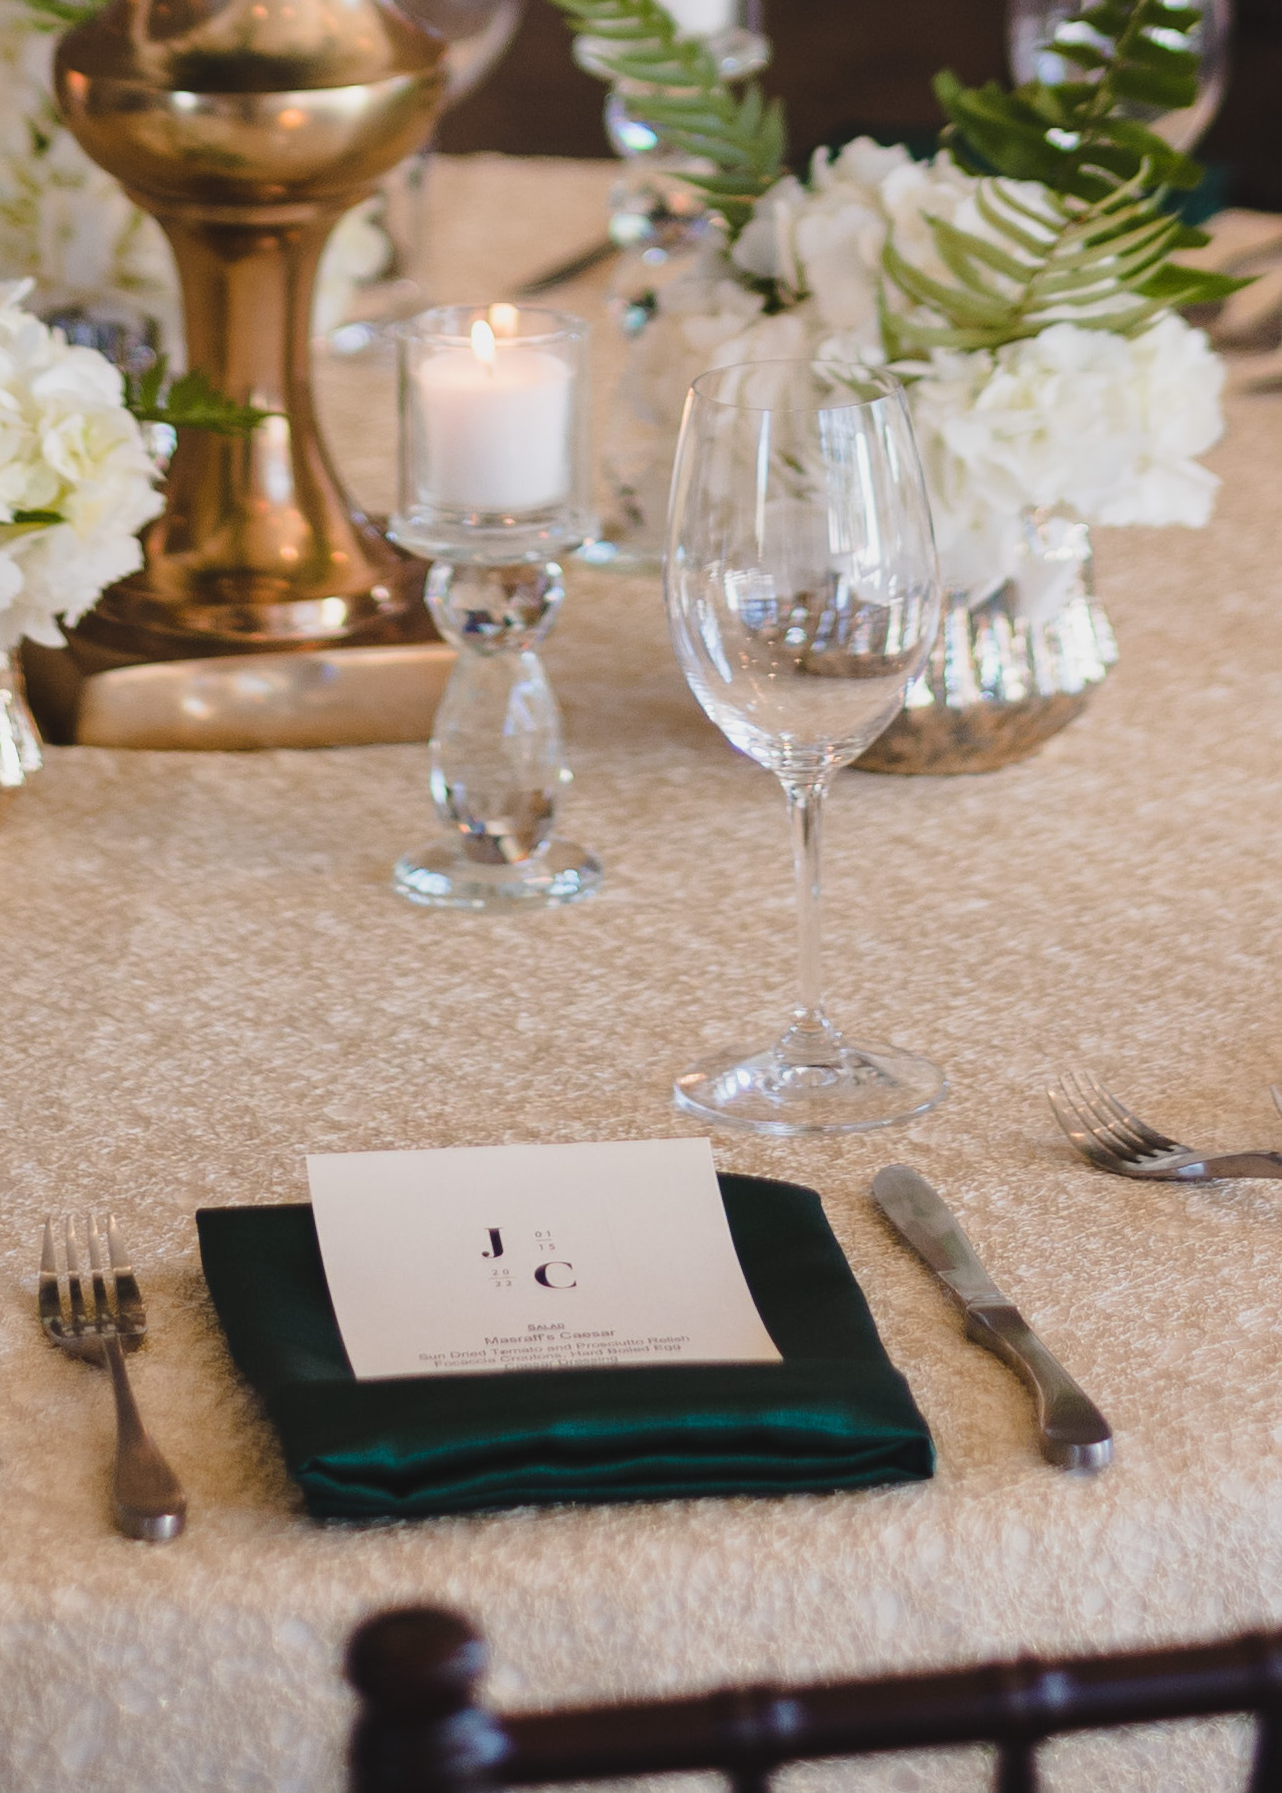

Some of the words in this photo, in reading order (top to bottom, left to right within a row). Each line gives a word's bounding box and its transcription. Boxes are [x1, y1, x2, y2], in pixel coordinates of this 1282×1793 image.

[481, 1226, 504, 1258] J
[539, 1243, 556, 1251] 15
[491, 1268, 510, 1276] 20
[534, 1261, 577, 1289] C
[418, 1352, 446, 1361] Sun
[450, 1350, 486, 1359] Dried
[491, 1346, 543, 1356] Tomato
[547, 1344, 571, 1352] and
[576, 1338, 644, 1349] Prosciutto
[647, 1335, 690, 1345] Relish
[484, 1333, 555, 1345] Masraff's
[560, 1329, 616, 1340] Caesar
[434, 1357, 496, 1367] Focaccia
[570, 1349, 603, 1358] Hard
[608, 1346, 649, 1356] Boiled
[654, 1344, 681, 1353] Egg
